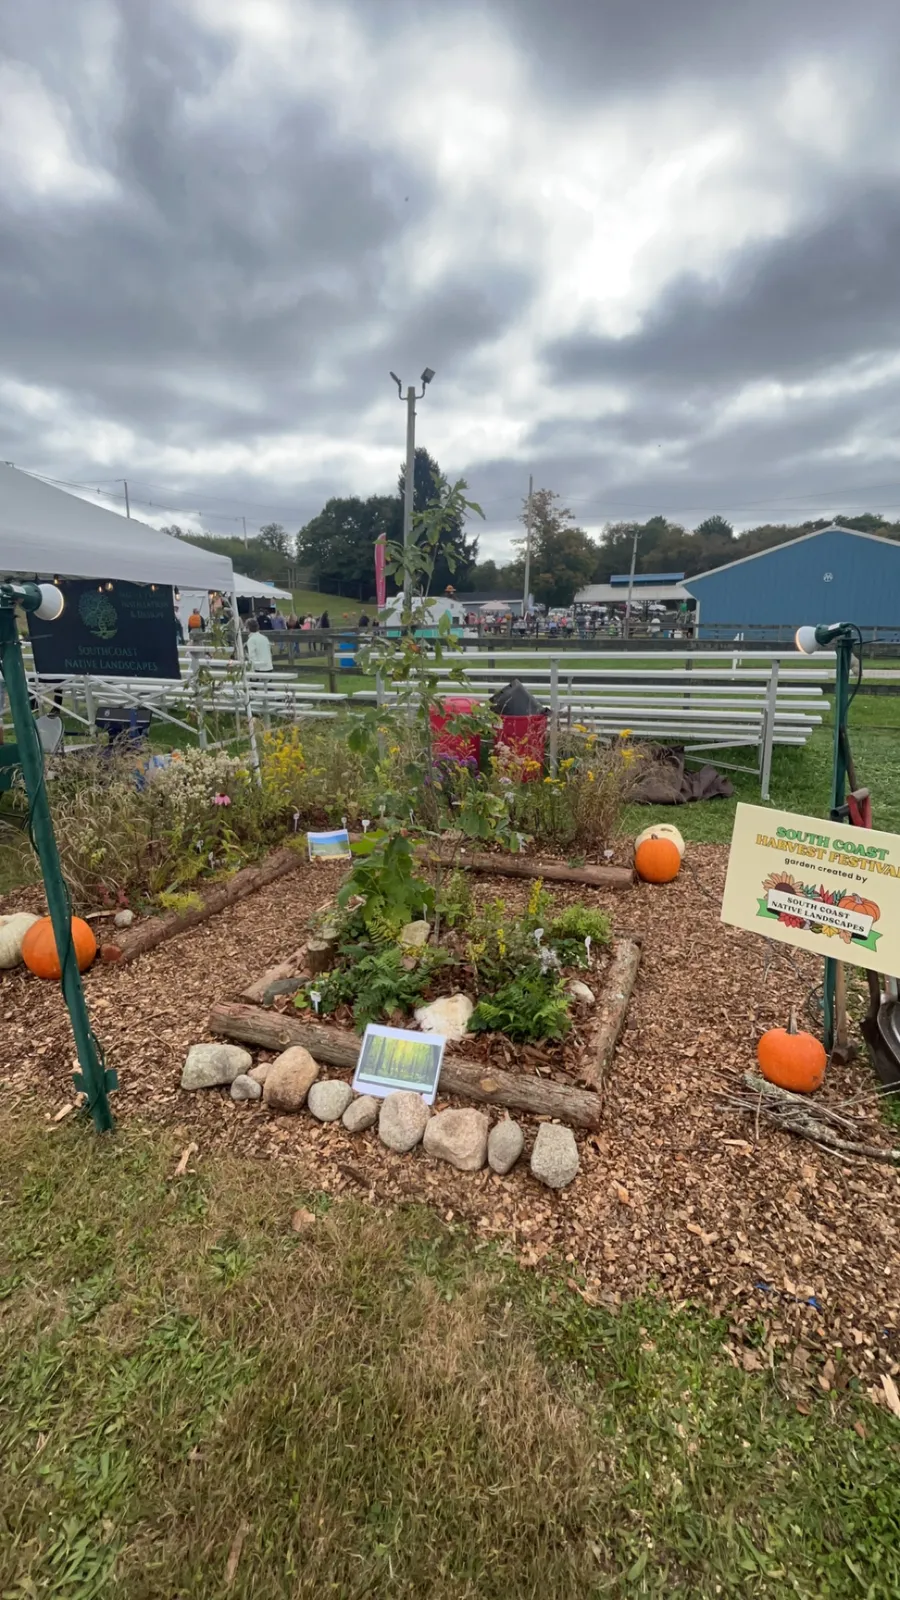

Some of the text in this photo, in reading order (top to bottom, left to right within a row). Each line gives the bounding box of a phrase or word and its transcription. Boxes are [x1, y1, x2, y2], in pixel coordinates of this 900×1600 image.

[755, 833, 827, 860] HARVEST
[776, 826, 889, 861] SOUTH COAST
[784, 856, 868, 884] garden created by
[771, 900, 865, 932] NATIVE LANDSCAPES
[787, 897, 851, 920] SOUTH COAST
